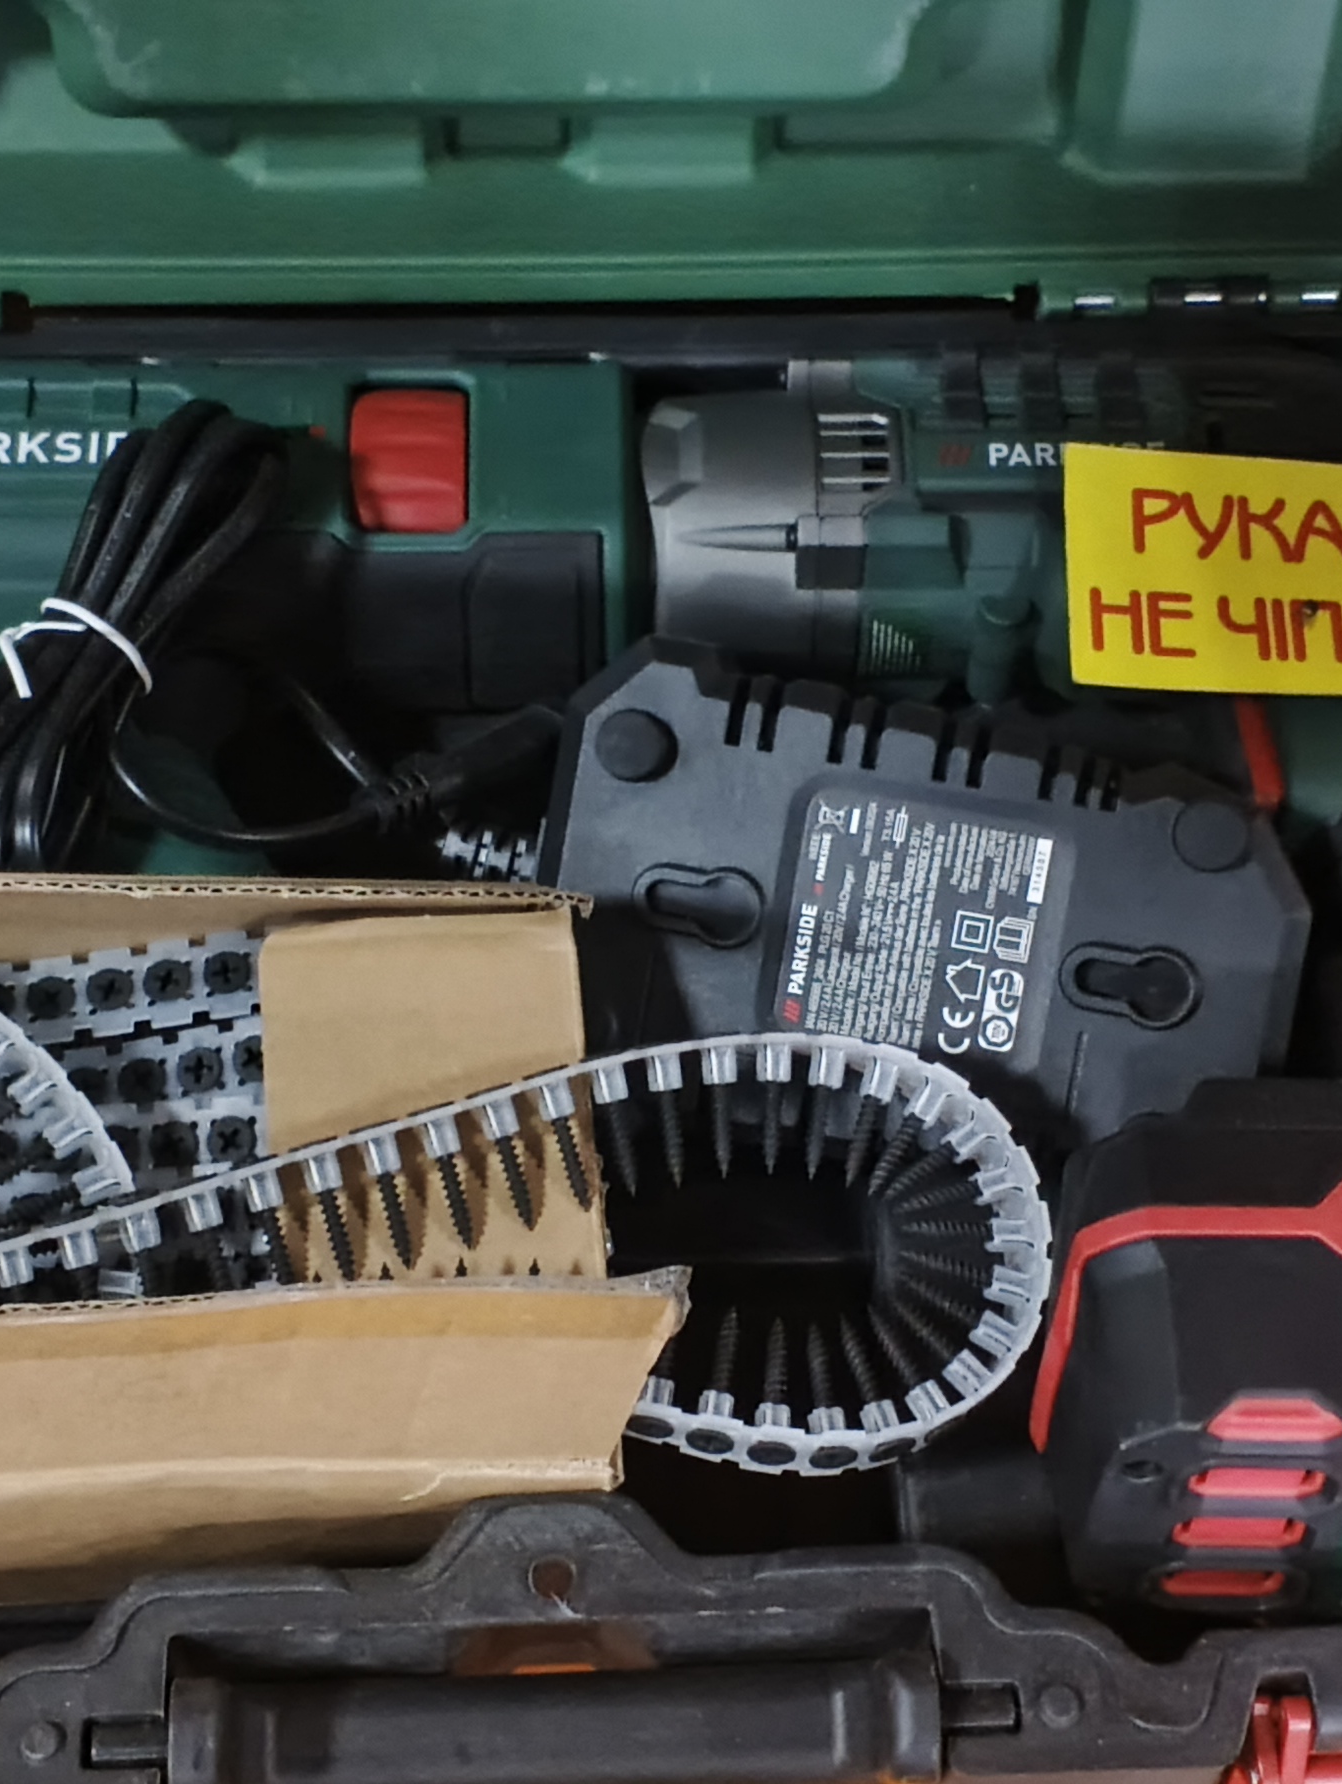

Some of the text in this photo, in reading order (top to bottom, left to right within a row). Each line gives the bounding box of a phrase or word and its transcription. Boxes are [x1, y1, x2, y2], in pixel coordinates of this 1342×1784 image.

[1089, 587, 1197, 658] НЕ
[815, 832, 831, 882] PARKSIDE
[787, 902, 817, 995] PARKSIDE
